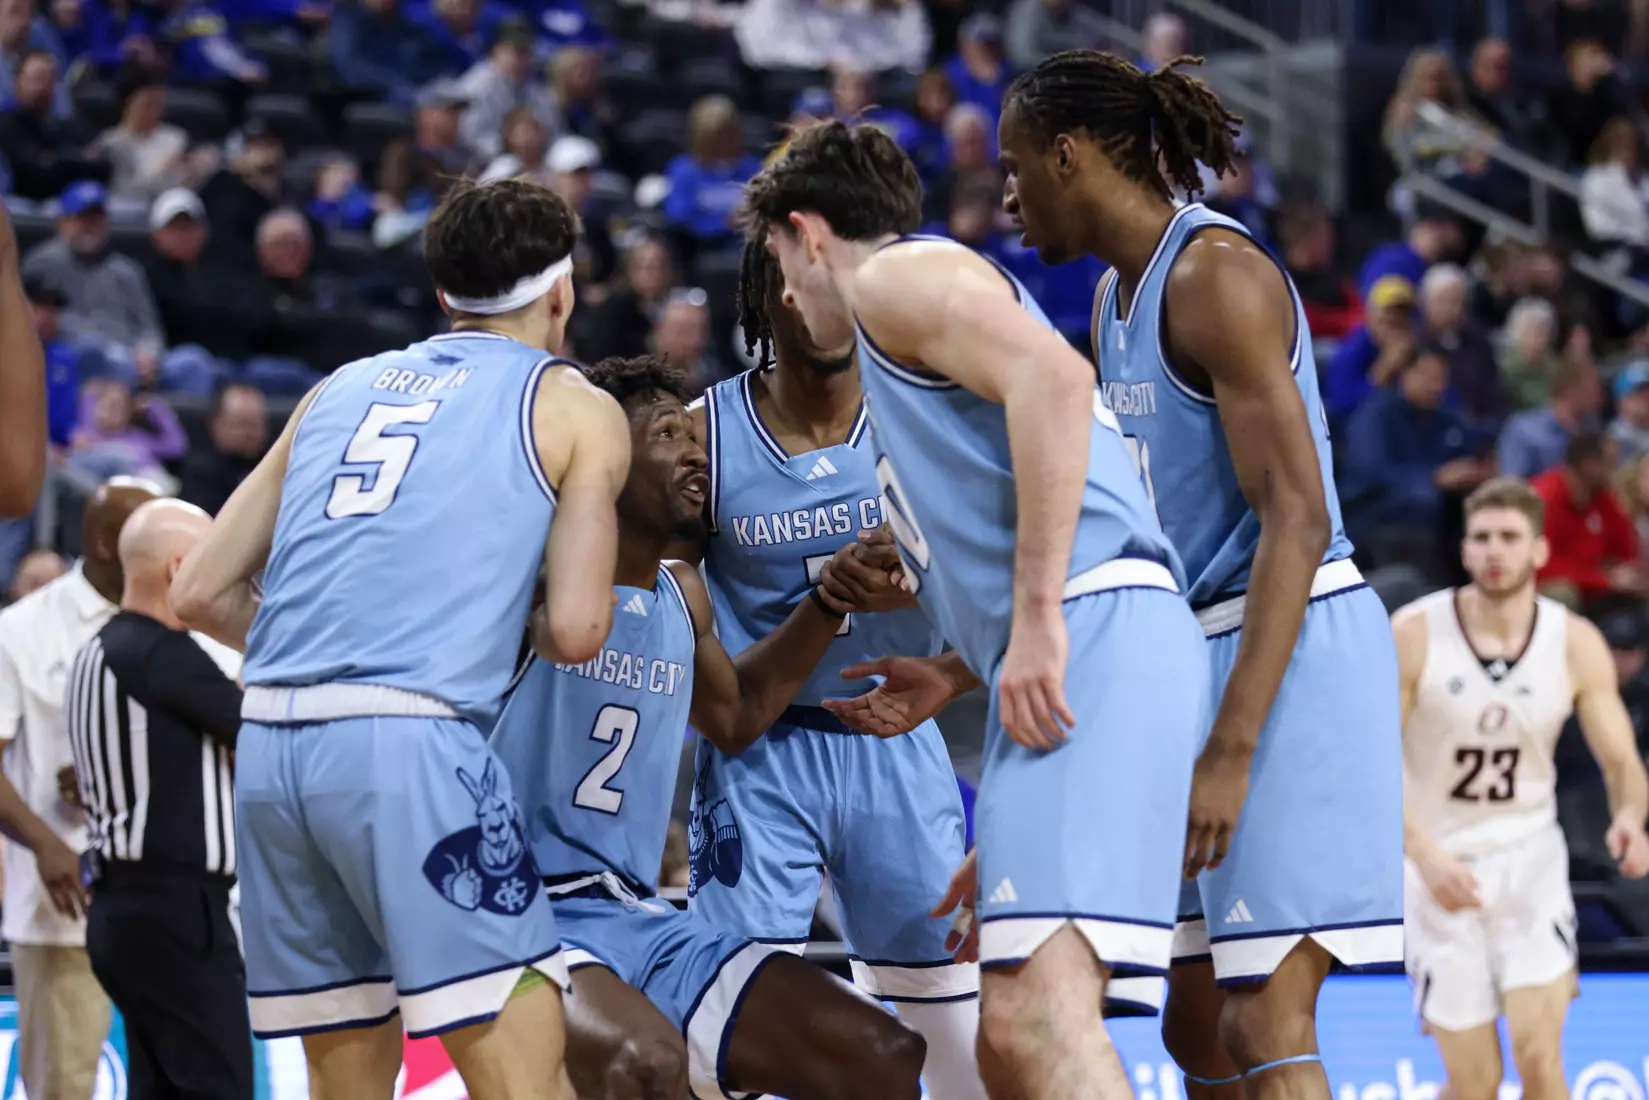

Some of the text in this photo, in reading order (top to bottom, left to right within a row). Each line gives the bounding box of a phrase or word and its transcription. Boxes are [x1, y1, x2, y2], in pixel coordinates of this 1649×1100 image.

[371, 366, 477, 396] BROWN
[324, 399, 443, 520] 5
[732, 495, 888, 546] KANSAS CI
[875, 452, 931, 595] 0
[572, 702, 640, 816] 2
[1450, 748, 1520, 801] 23
